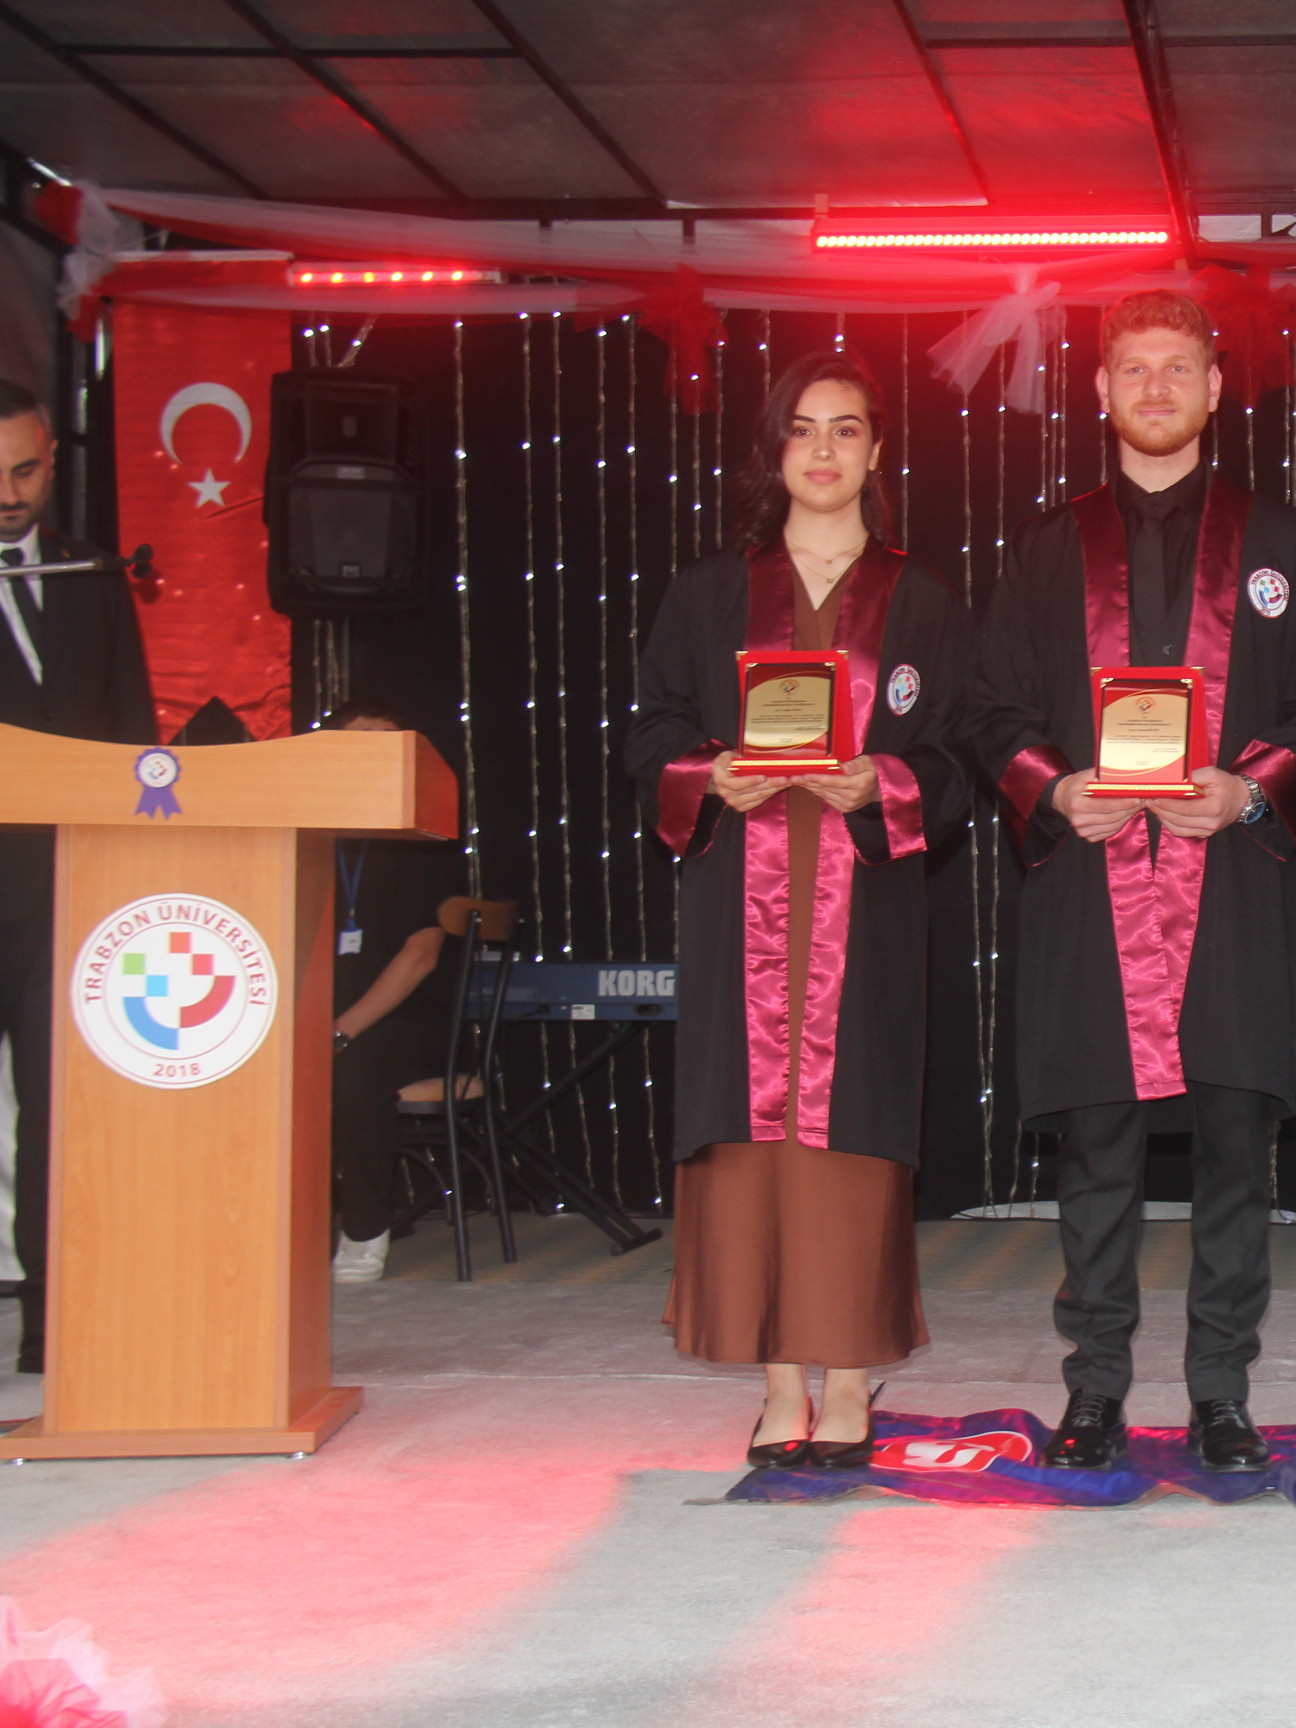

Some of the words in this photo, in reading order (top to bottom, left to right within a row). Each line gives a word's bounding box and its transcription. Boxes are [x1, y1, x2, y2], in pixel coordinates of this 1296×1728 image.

[84, 910, 150, 1004] TRABZON
[157, 902, 270, 1007] ÜNİVERSİTESİ
[598, 970, 676, 997] KORG
[153, 1062, 201, 1077] 2018
